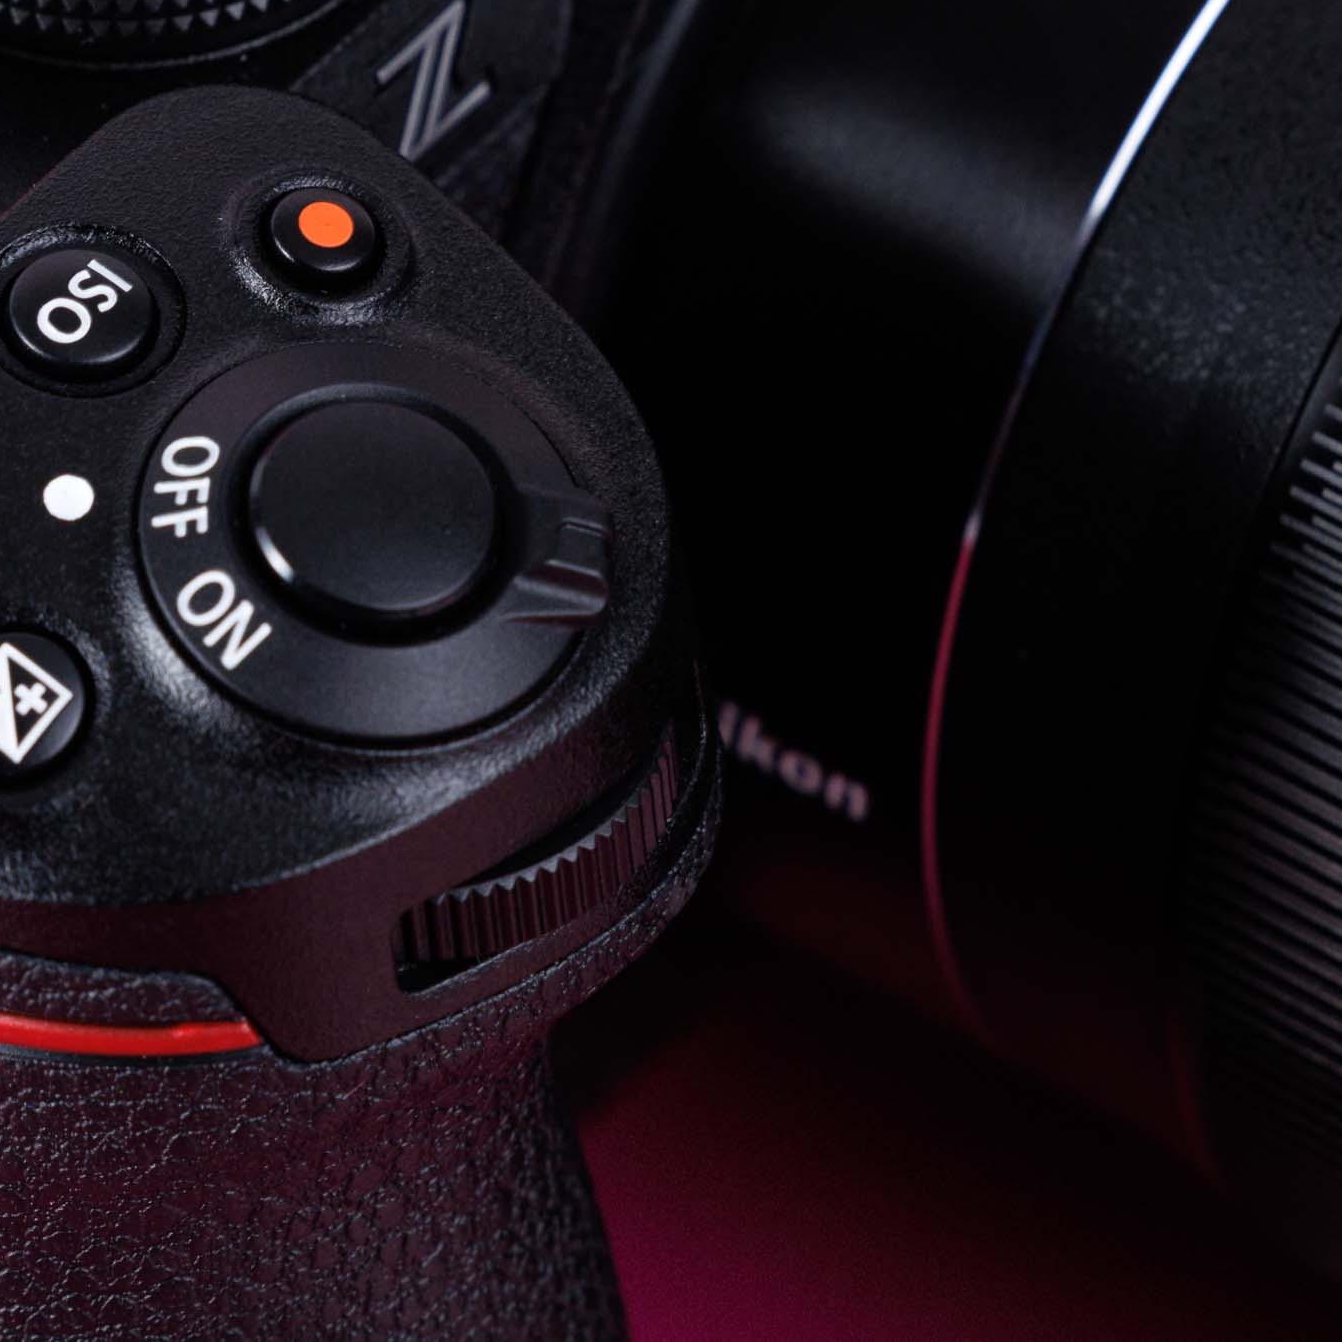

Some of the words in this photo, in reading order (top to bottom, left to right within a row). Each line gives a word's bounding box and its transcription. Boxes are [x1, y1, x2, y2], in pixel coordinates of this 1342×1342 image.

[35, 257, 134, 345] ISO
[149, 434, 222, 539] OFF
[175, 568, 274, 672] ON
[716, 701, 869, 822] ikon
